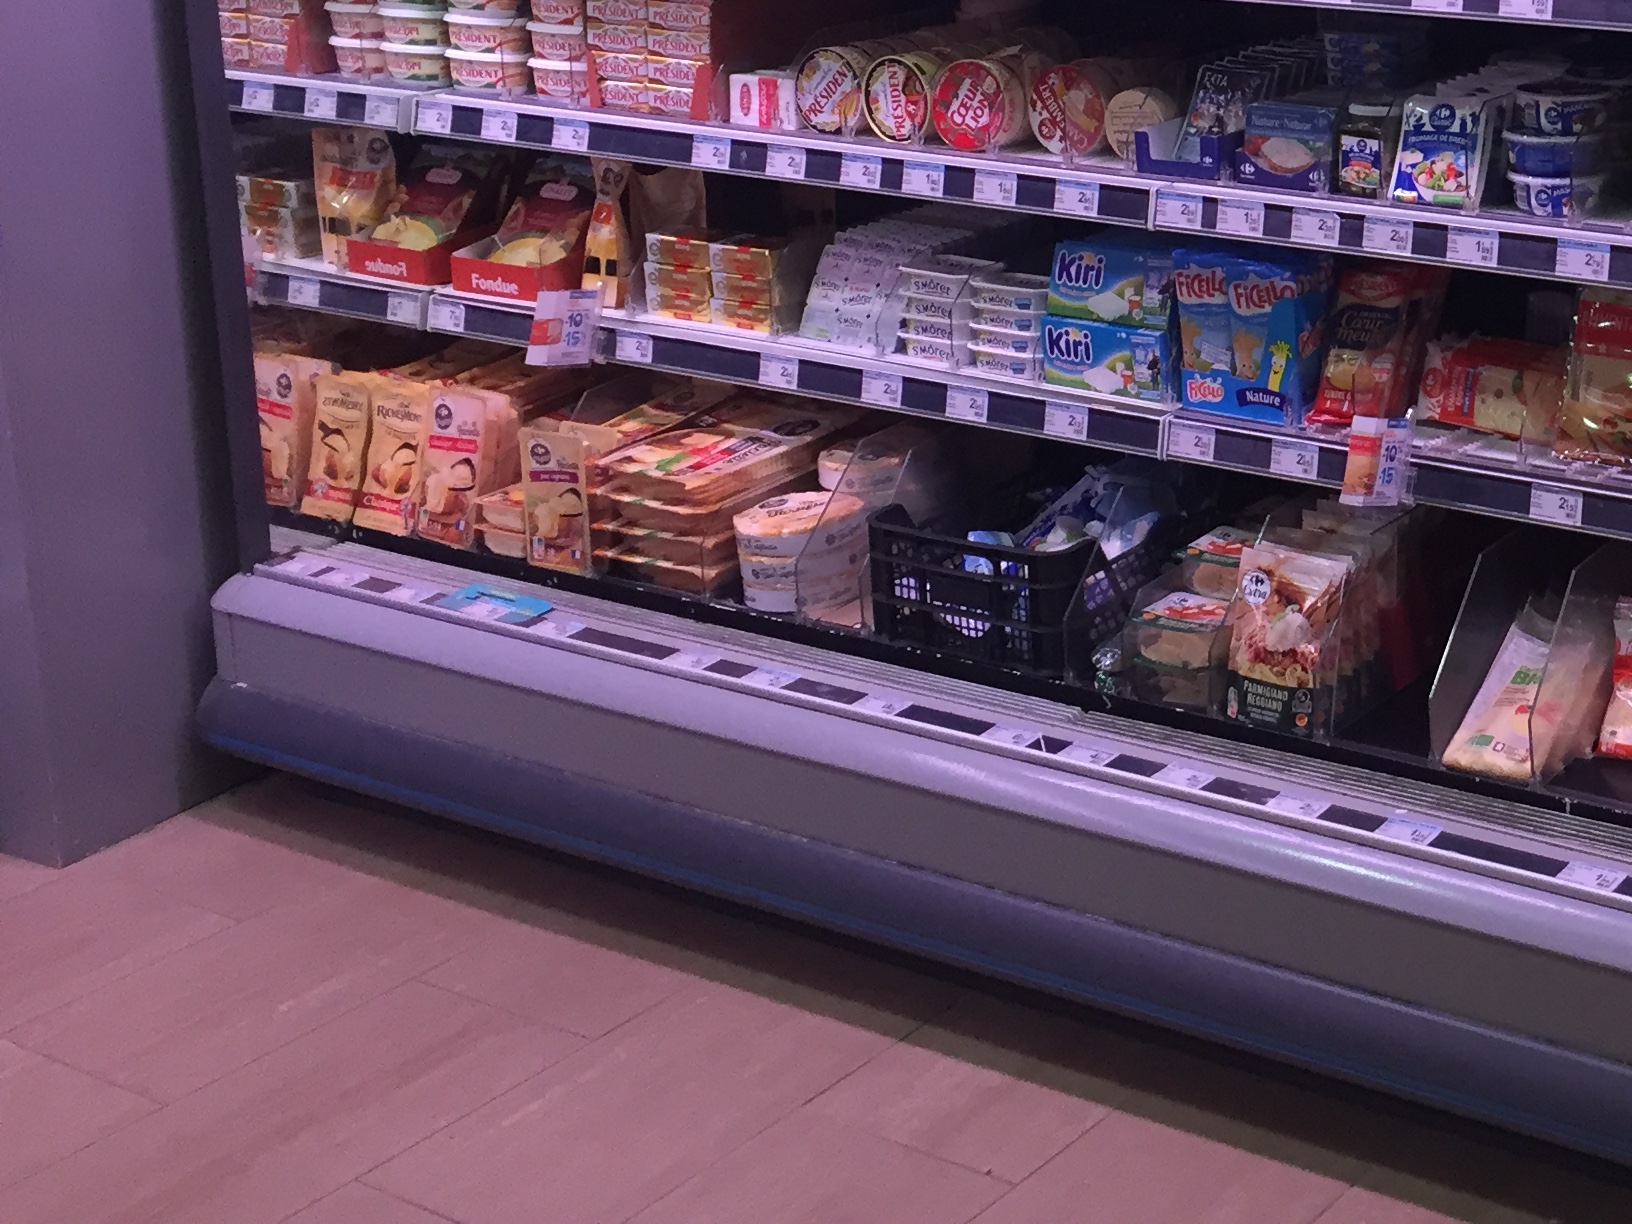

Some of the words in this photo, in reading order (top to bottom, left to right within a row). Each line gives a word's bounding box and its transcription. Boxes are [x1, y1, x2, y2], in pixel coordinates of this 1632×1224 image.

[470, 273, 520, 295] Fondue
[1055, 249, 1106, 290] Kiri
[1045, 326, 1092, 363] Kiri
[1245, 391, 1281, 407] Nature
